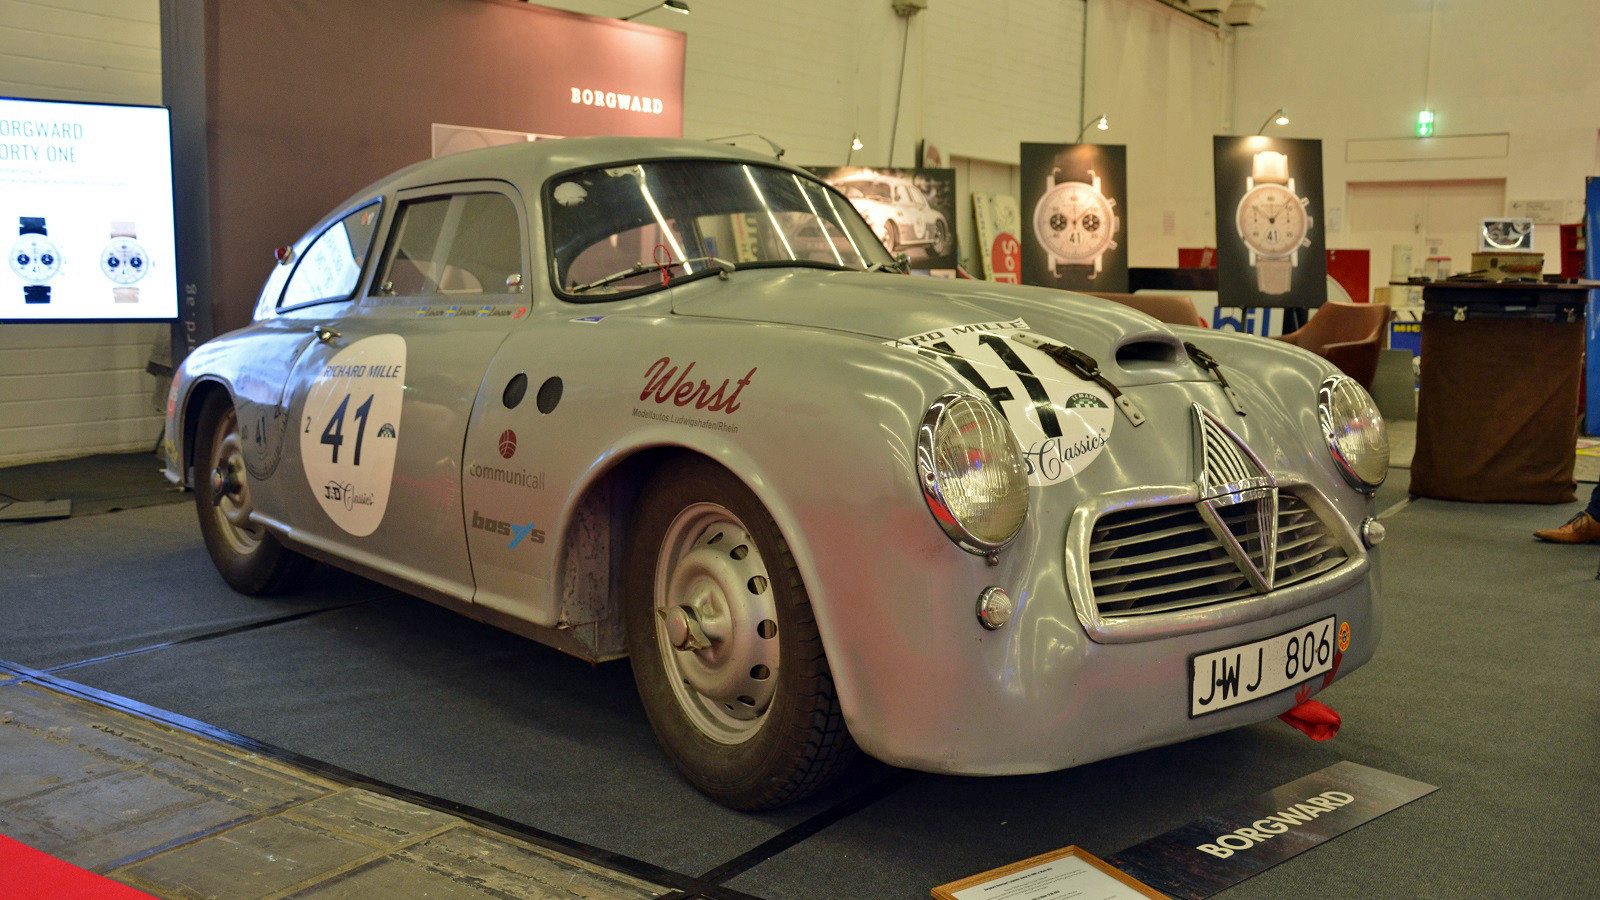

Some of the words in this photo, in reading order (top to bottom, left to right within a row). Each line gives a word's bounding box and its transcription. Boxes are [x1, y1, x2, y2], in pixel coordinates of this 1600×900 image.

[571, 87, 663, 114] BORGWARD
[47, 145, 77, 163] ONE
[1069, 232, 1080, 244] 41
[1267, 230, 1278, 241] 41
[951, 320, 1027, 335] MILLE
[323, 365, 366, 378] RICHARD
[367, 365, 401, 378] MILLE
[639, 357, 757, 414] Werst
[1079, 393, 1097, 401] MANS
[304, 416, 312, 434] 2
[320, 393, 375, 466] 41
[632, 408, 670, 423] Modellautos
[670, 414, 739, 434] Ludwigshafen/Rhein
[1038, 433, 1108, 481] Classics
[469, 464, 545, 491] communicall
[1198, 647, 1263, 706] JWJ
[1285, 624, 1330, 680] 806
[1196, 790, 1356, 860] BORGWARD
